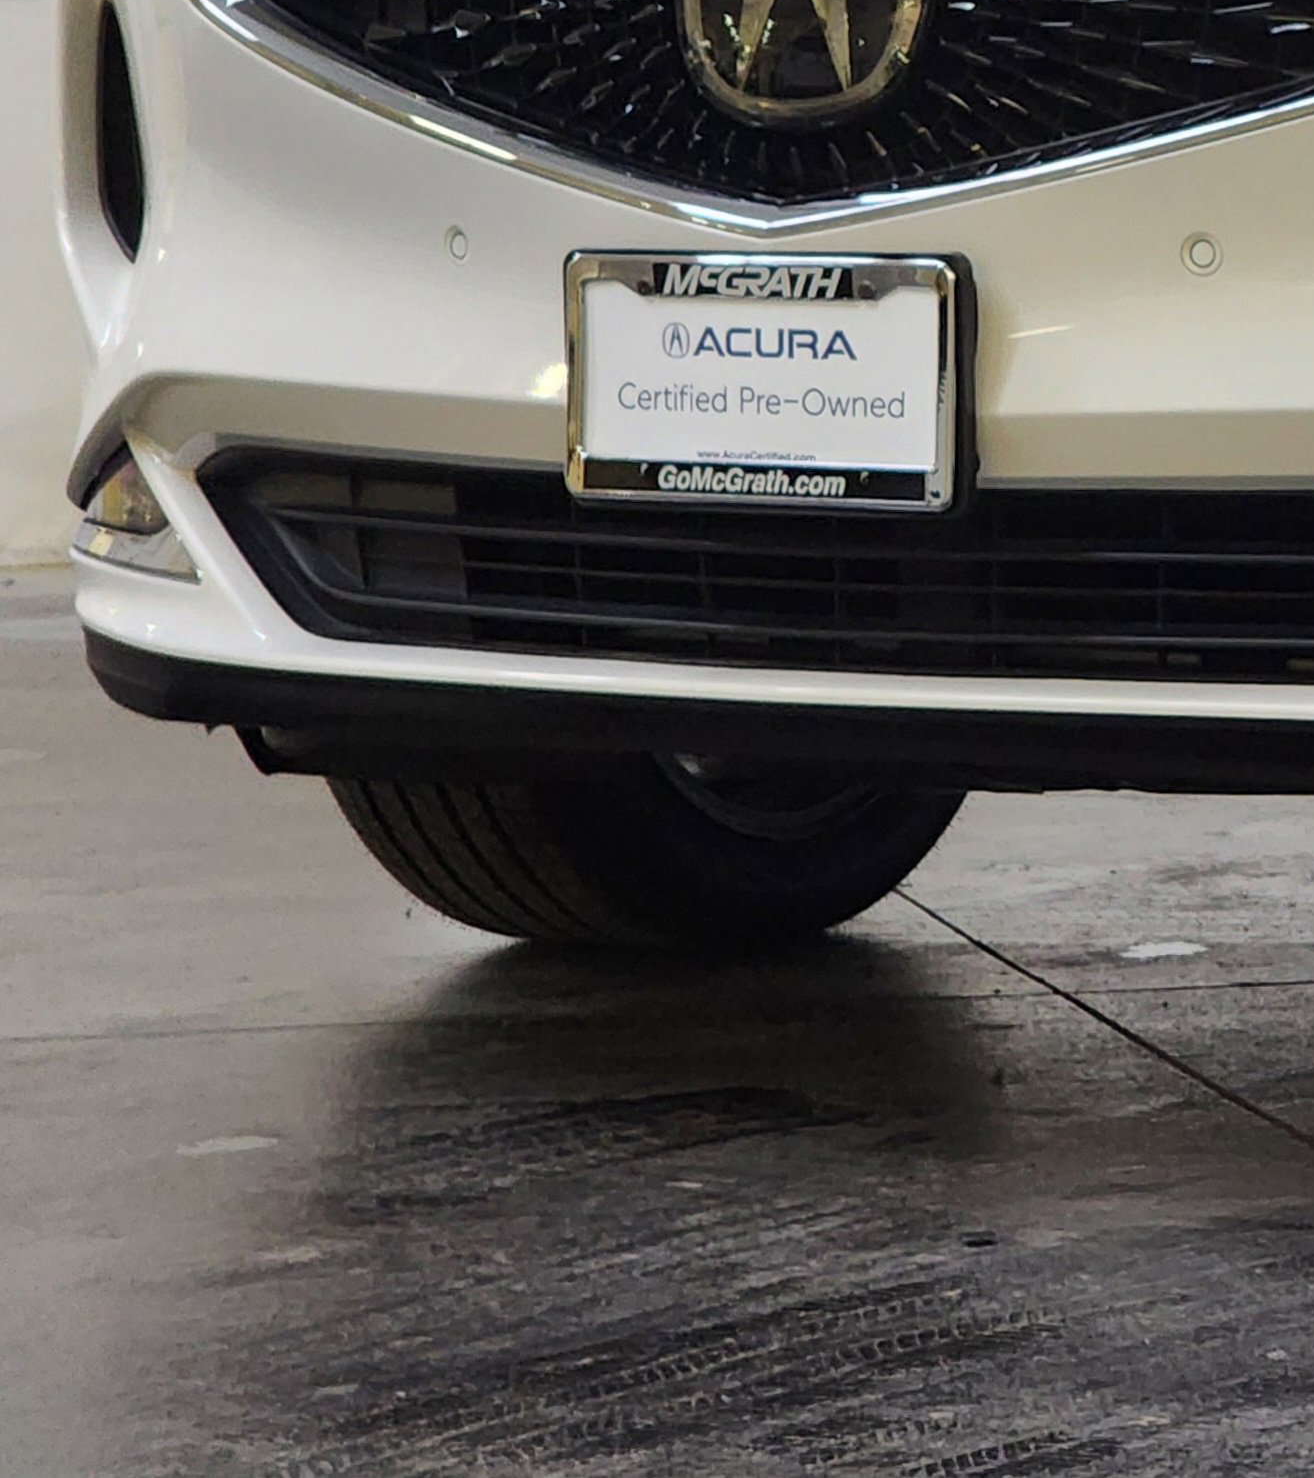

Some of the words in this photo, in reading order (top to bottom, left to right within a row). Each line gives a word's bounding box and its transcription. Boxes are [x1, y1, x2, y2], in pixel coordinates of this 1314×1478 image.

[662, 263, 843, 299] McGRATH
[693, 326, 857, 360] ACURA
[617, 381, 728, 413] Certified
[739, 386, 906, 418] Pre-Owned
[657, 465, 846, 497] GoMcGrath.com
